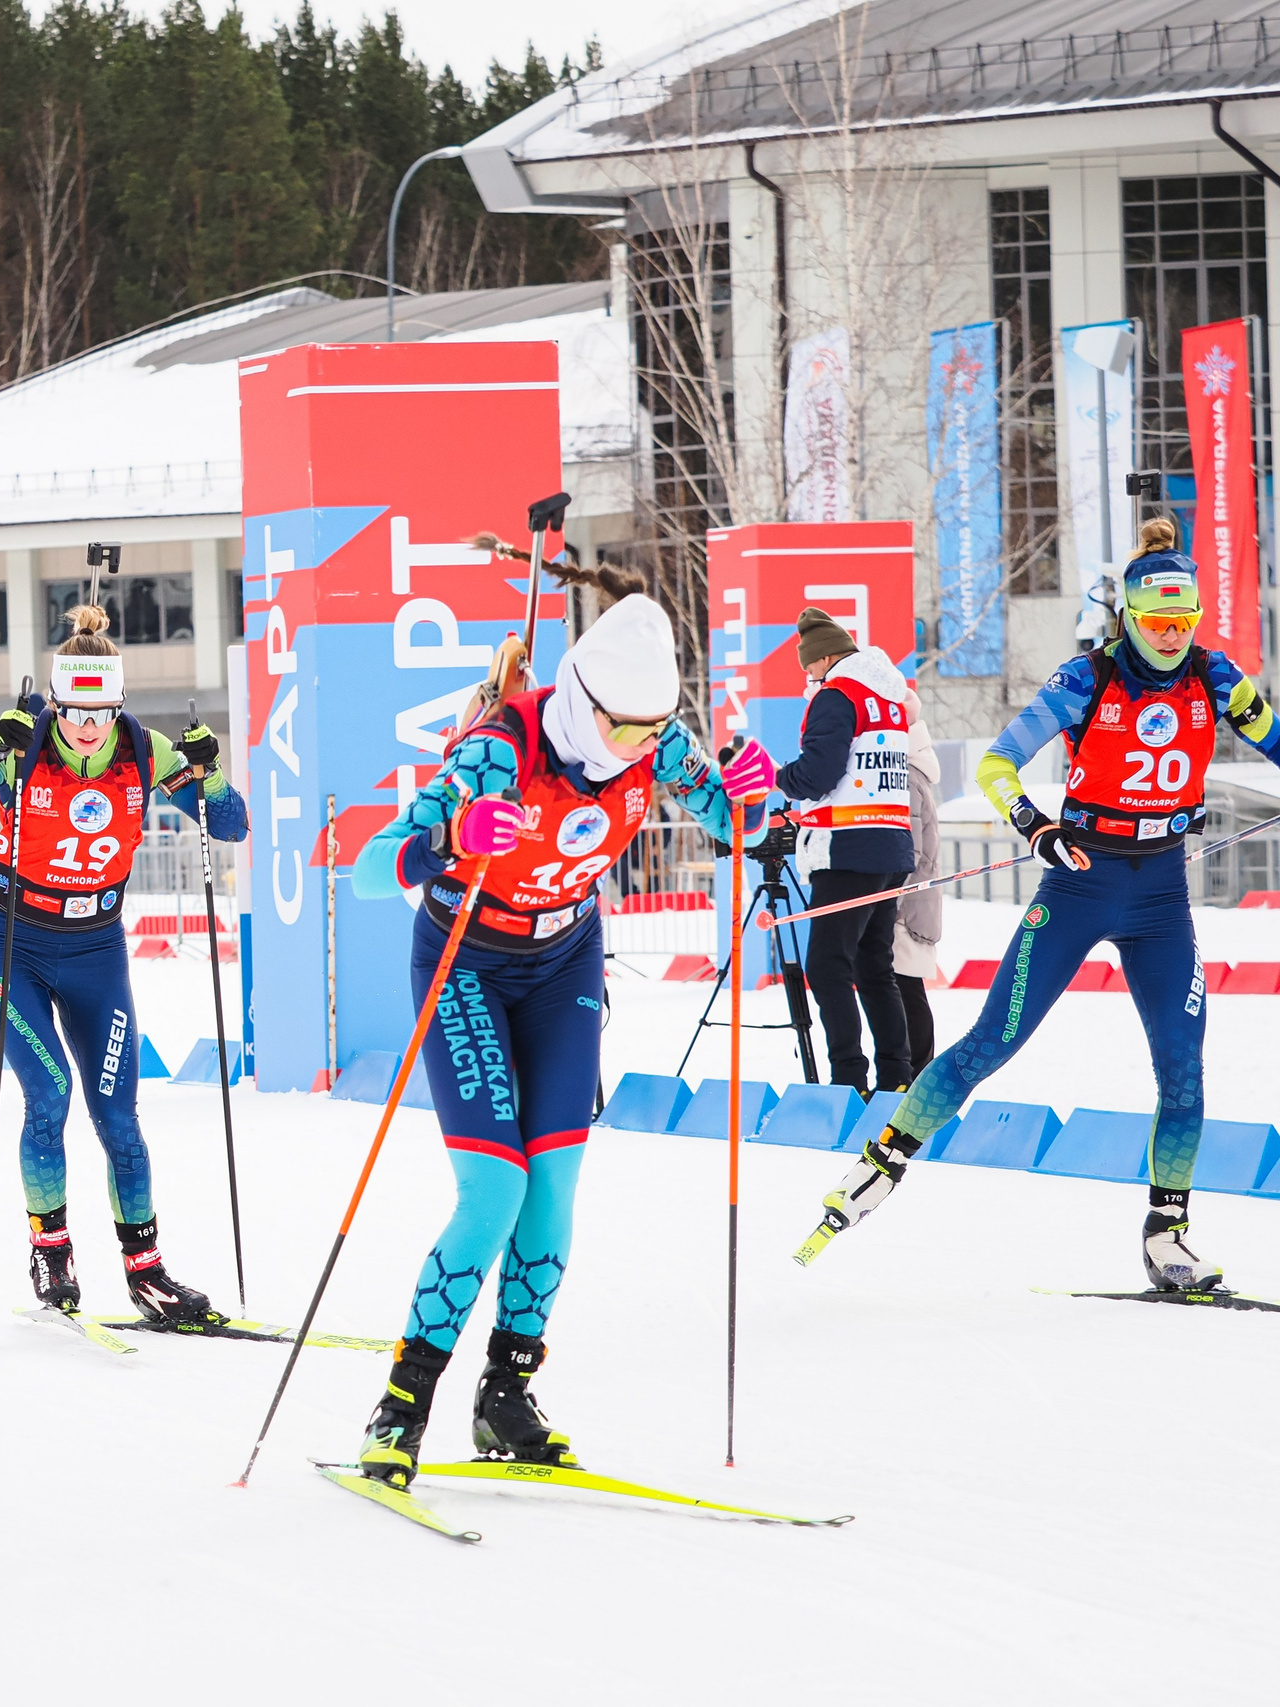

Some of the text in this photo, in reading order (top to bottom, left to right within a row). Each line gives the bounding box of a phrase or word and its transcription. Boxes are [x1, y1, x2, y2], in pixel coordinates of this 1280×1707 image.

[264, 524, 303, 925] СТАРТ
[1066, 766, 1085, 790] 0
[1121, 750, 1191, 792] 20
[1119, 797, 1180, 807] КРАСНОЯРСК
[197, 798, 213, 884] barnett
[49, 836, 120, 872] 19
[1002, 931, 1035, 1043] БЕЛОРУСНЕФТЬ
[103, 1008, 128, 1074] BEEU
[436, 982, 483, 1101] ОБЛАСТЬ
[1164, 1194, 1183, 1202] 170
[136, 1225, 155, 1238] 169
[1186, 1294, 1214, 1302] FISCHER
[177, 1324, 204, 1332] FISCHER
[319, 1334, 395, 1347] FISCHER
[510, 1350, 532, 1364] 168
[505, 1465, 552, 1477] FISCHER
